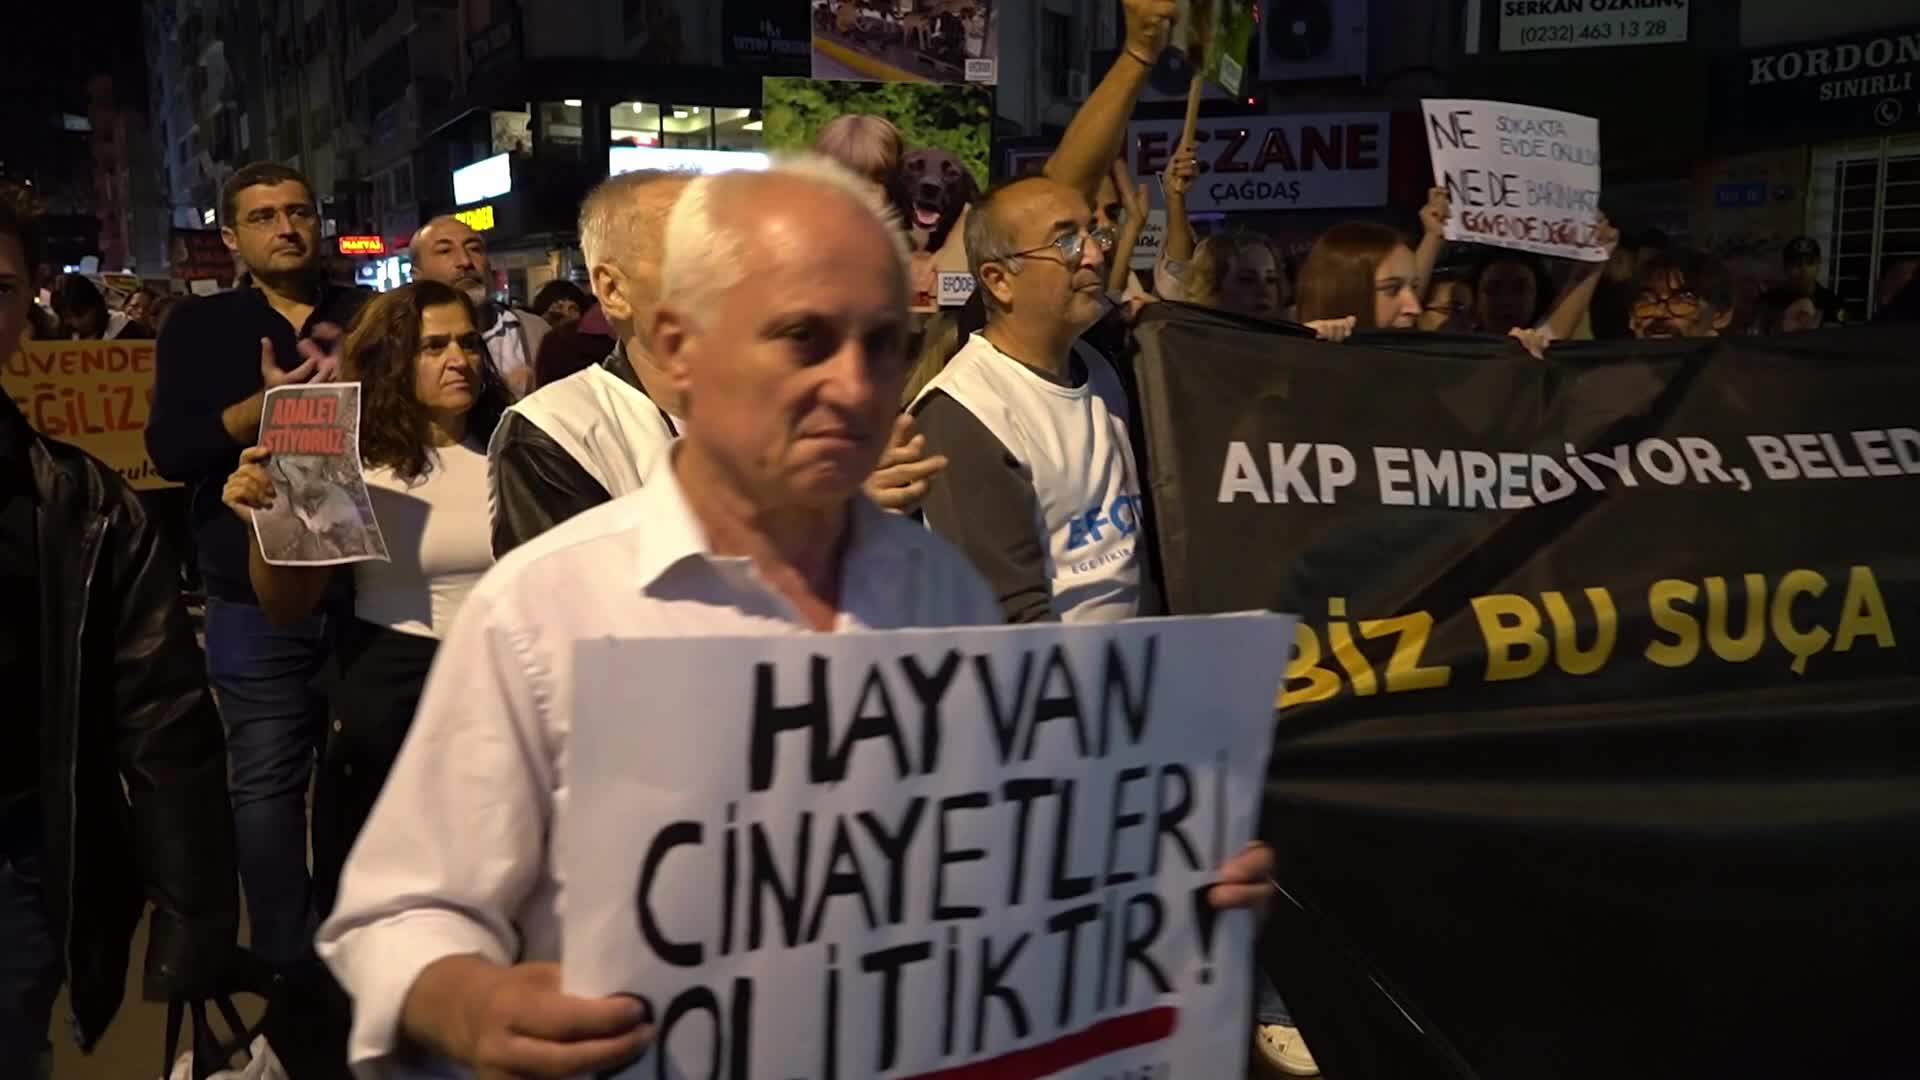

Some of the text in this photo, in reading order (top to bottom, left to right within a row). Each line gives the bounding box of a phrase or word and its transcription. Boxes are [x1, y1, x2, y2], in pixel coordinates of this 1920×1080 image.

[1520, 19, 1667, 45] (0232) 463 13 28
[1749, 31, 1920, 86] KORDON
[1819, 71, 1912, 102] SINIRLI
[1429, 110, 1480, 150] NE
[1499, 137, 1549, 158] EVDE
[1209, 180, 1301, 207] ÇAĞDAŞ
[1444, 169, 1484, 207] NE
[1488, 170, 1521, 208] DE
[1217, 427, 1920, 510] AKP EMREDİYOR, BELED
[1275, 565, 1896, 709] BİZ BU SUÇA
[748, 634, 1160, 793] HAYVAN
[636, 749, 1229, 968] CİNAYETLERİ
